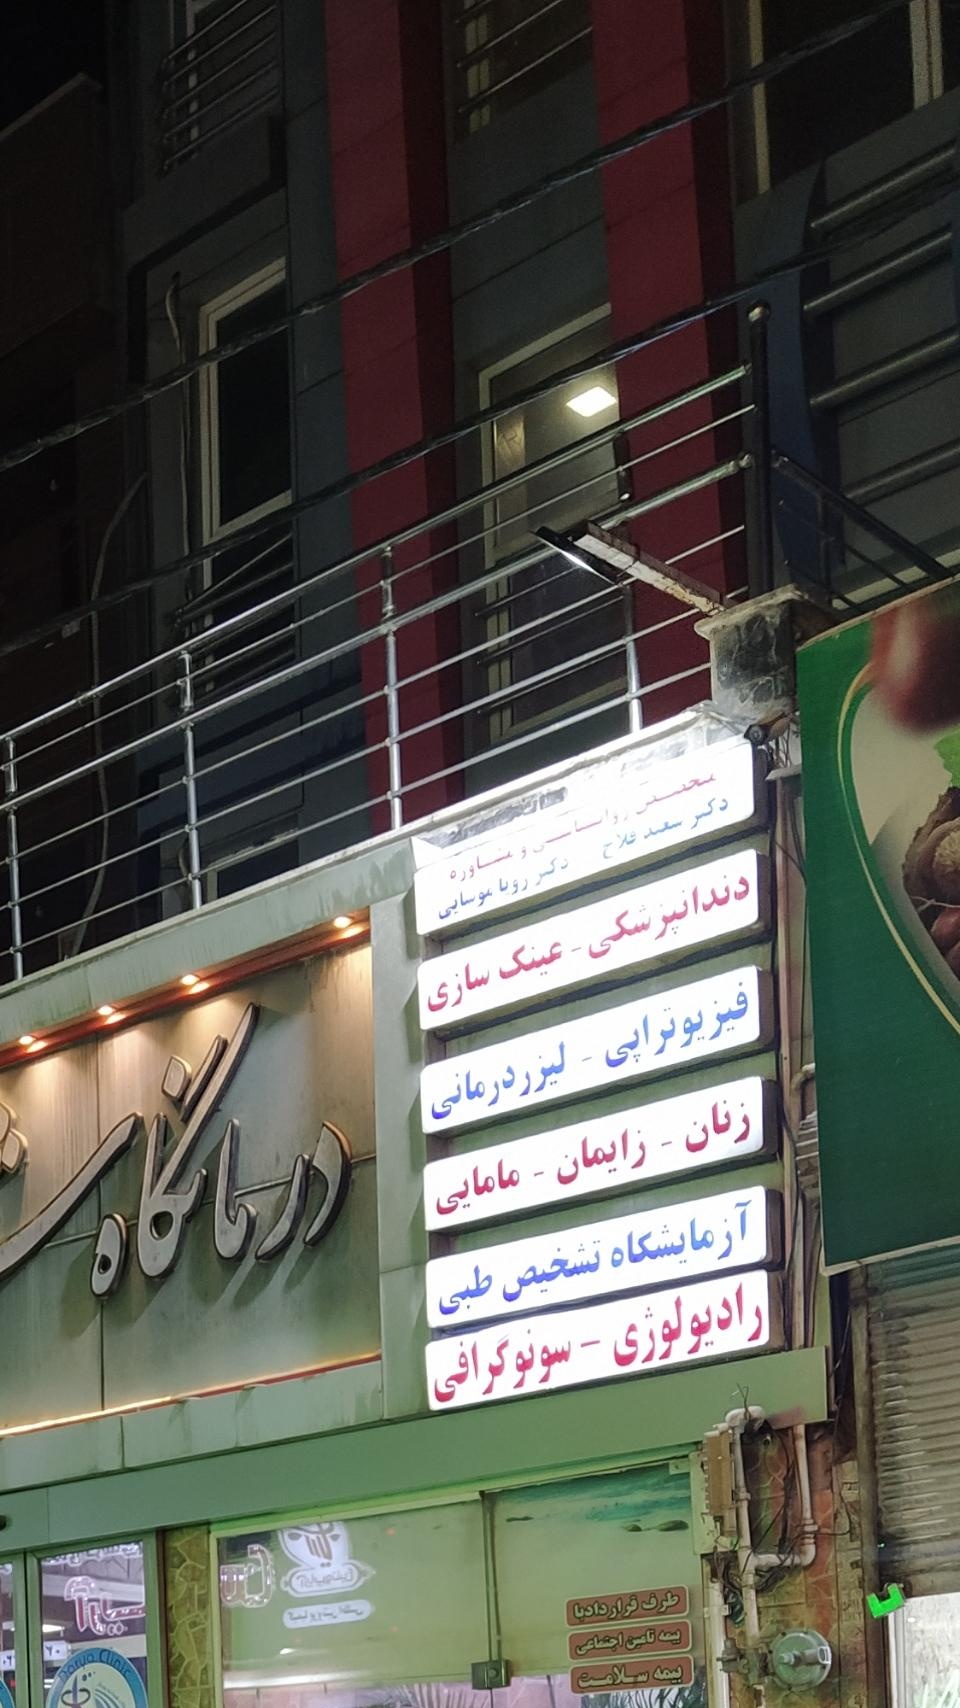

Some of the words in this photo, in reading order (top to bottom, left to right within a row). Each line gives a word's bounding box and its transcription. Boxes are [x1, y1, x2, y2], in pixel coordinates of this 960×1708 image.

[587, 873, 751, 959] دندانپزشکی
[498, 940, 563, 979] عینک
[426, 961, 490, 1012] سازی
[605, 981, 749, 1068] فیزیوتراپی
[90, 1003, 353, 1301] درمانگاه
[685, 1100, 752, 1153] زنان
[556, 1128, 647, 1185] زایمان
[435, 1158, 521, 1215] مامایی
[438, 1265, 494, 1315] طبی
[502, 1239, 601, 1302] تشخیص
[612, 1283, 764, 1367] رادیولوژی
[433, 1328, 572, 1403] سونوگرافی
[640, 1591, 679, 1613] طرف
[99, 1648, 132, 1676] Clinic
[575, 1631, 624, 1656] اجتماعی
[658, 1628, 681, 1646] بیمه
[577, 1665, 649, 1689] سلامت
[653, 1664, 683, 1685] بیمه
